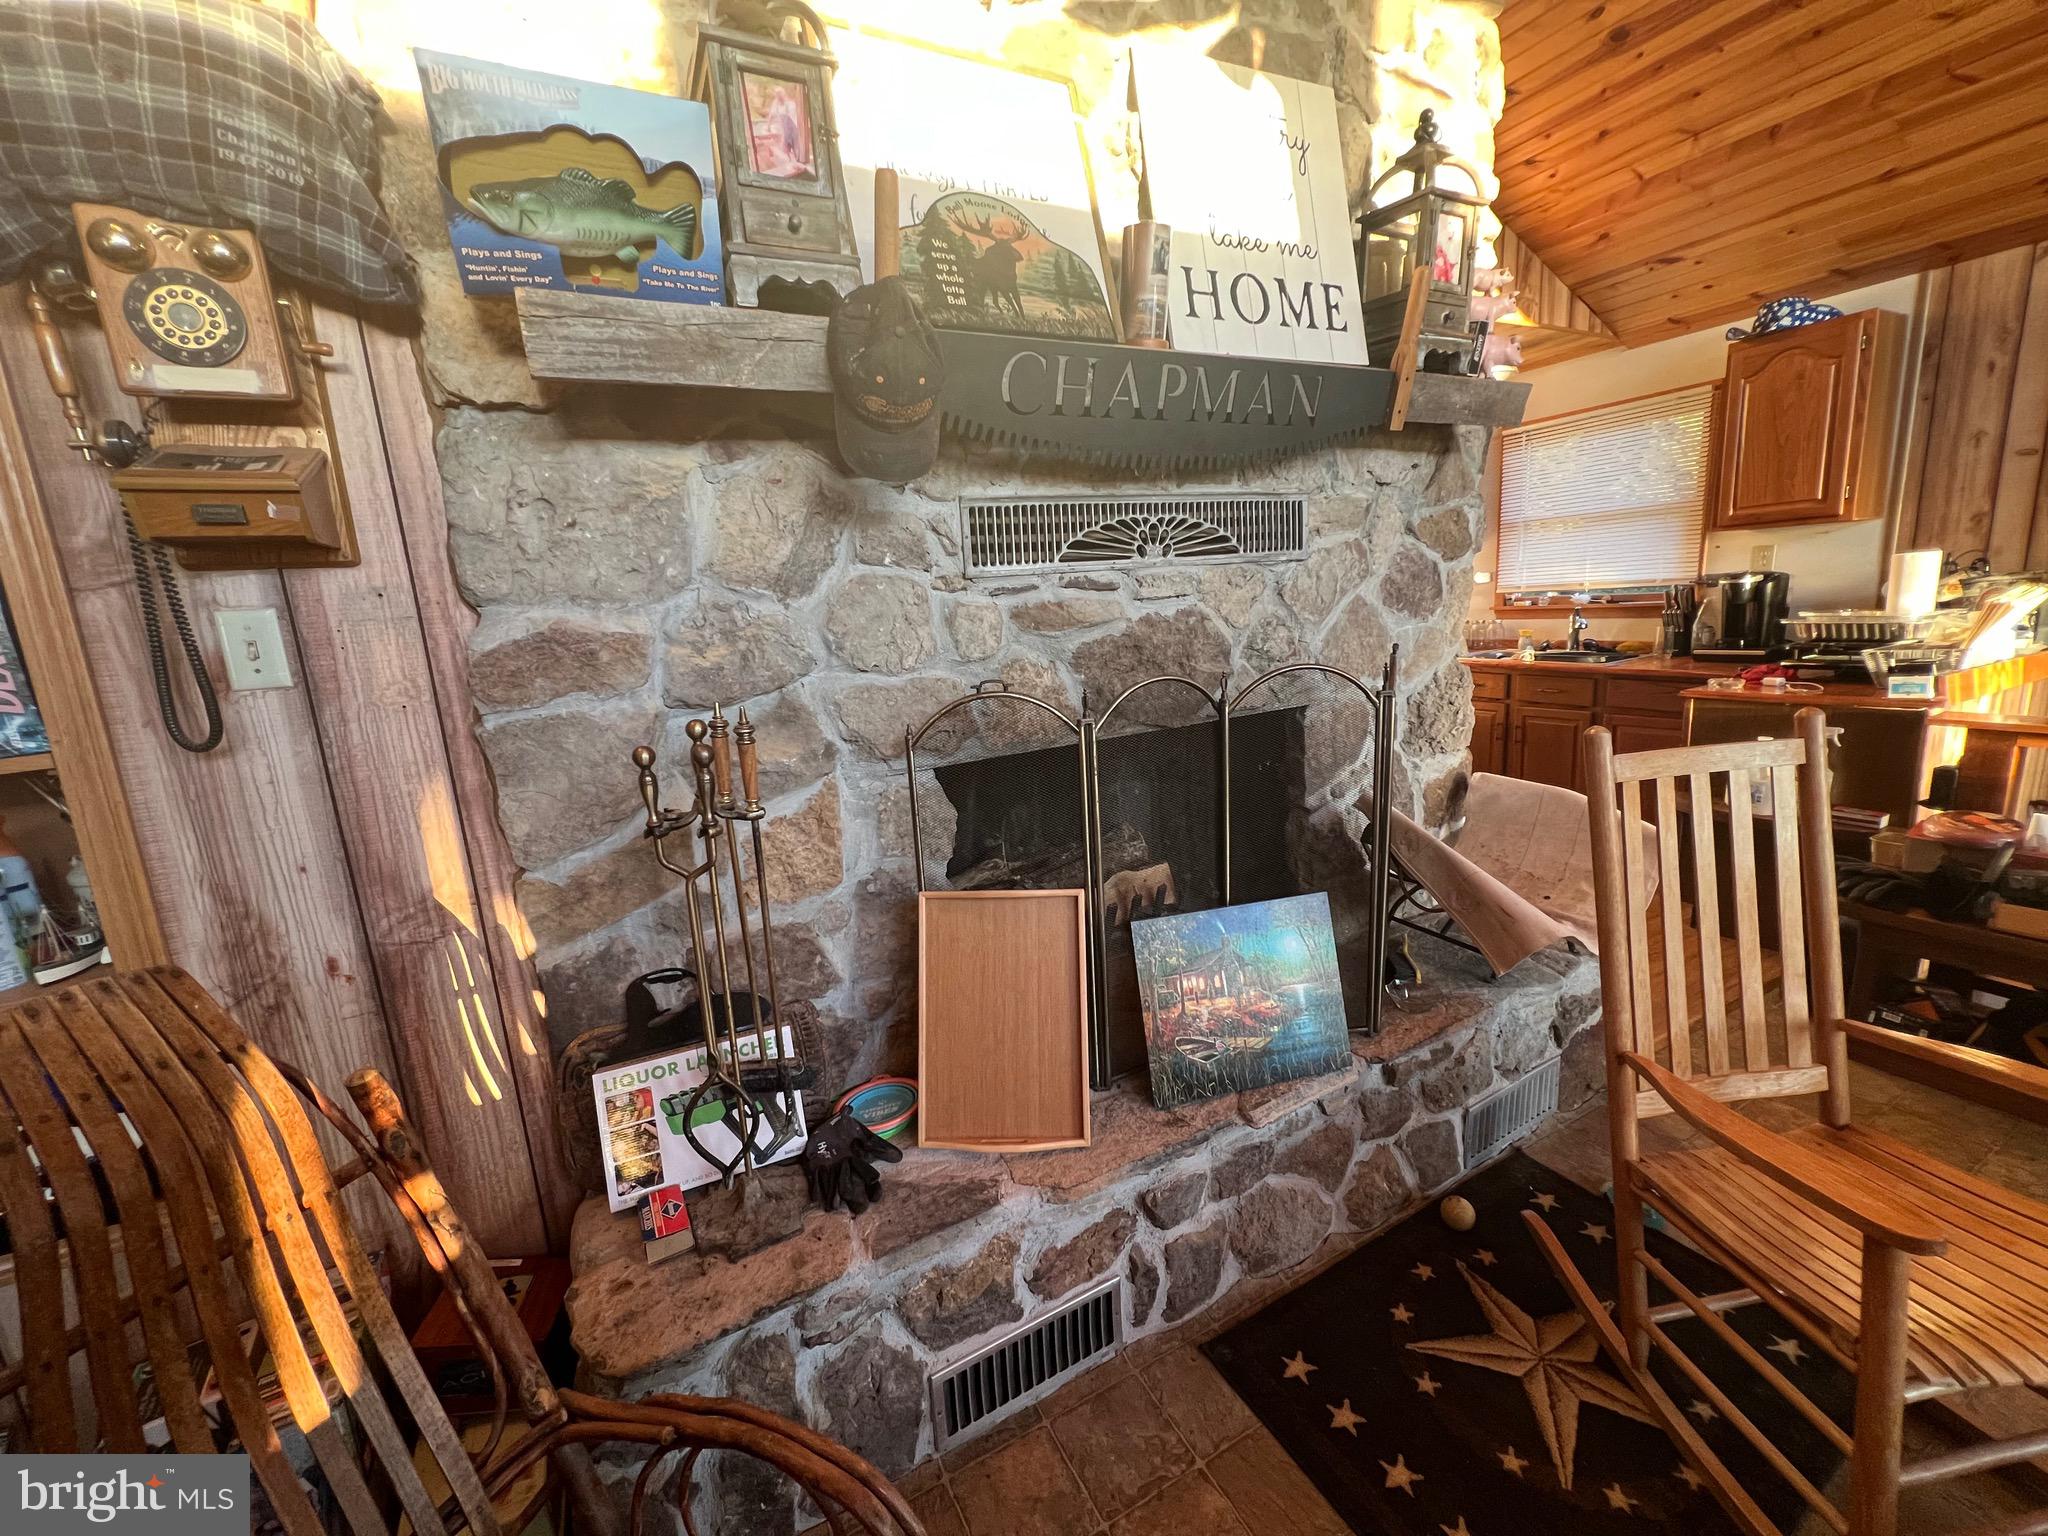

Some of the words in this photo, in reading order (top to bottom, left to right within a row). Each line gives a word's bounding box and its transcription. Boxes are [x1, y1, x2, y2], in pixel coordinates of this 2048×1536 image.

[428, 63, 460, 94] BIG
[461, 68, 513, 97] MOUTH
[216, 128, 296, 167] Chapman
[964, 197, 997, 210] Moose
[931, 238, 949, 249] We
[1276, 240, 1319, 260] me
[461, 247, 490, 258] Plays
[493, 250, 512, 258] and
[514, 250, 543, 261] Sings
[931, 251, 957, 261] serve
[652, 265, 676, 276] Plays
[679, 270, 695, 278] and
[697, 271, 719, 282] Sings
[936, 263, 950, 272] up
[951, 264, 958, 272] a
[510, 276, 532, 284] Every
[935, 273, 965, 284] whole
[687, 283, 699, 291] The
[942, 283, 965, 295] lotta
[947, 295, 967, 306] Bull
[1180, 266, 1348, 333] HOME
[1001, 351, 1325, 428] CHAPMAN
[602, 1061, 680, 1093] LIQUOR
[686, 1036, 780, 1072] LANCHE
